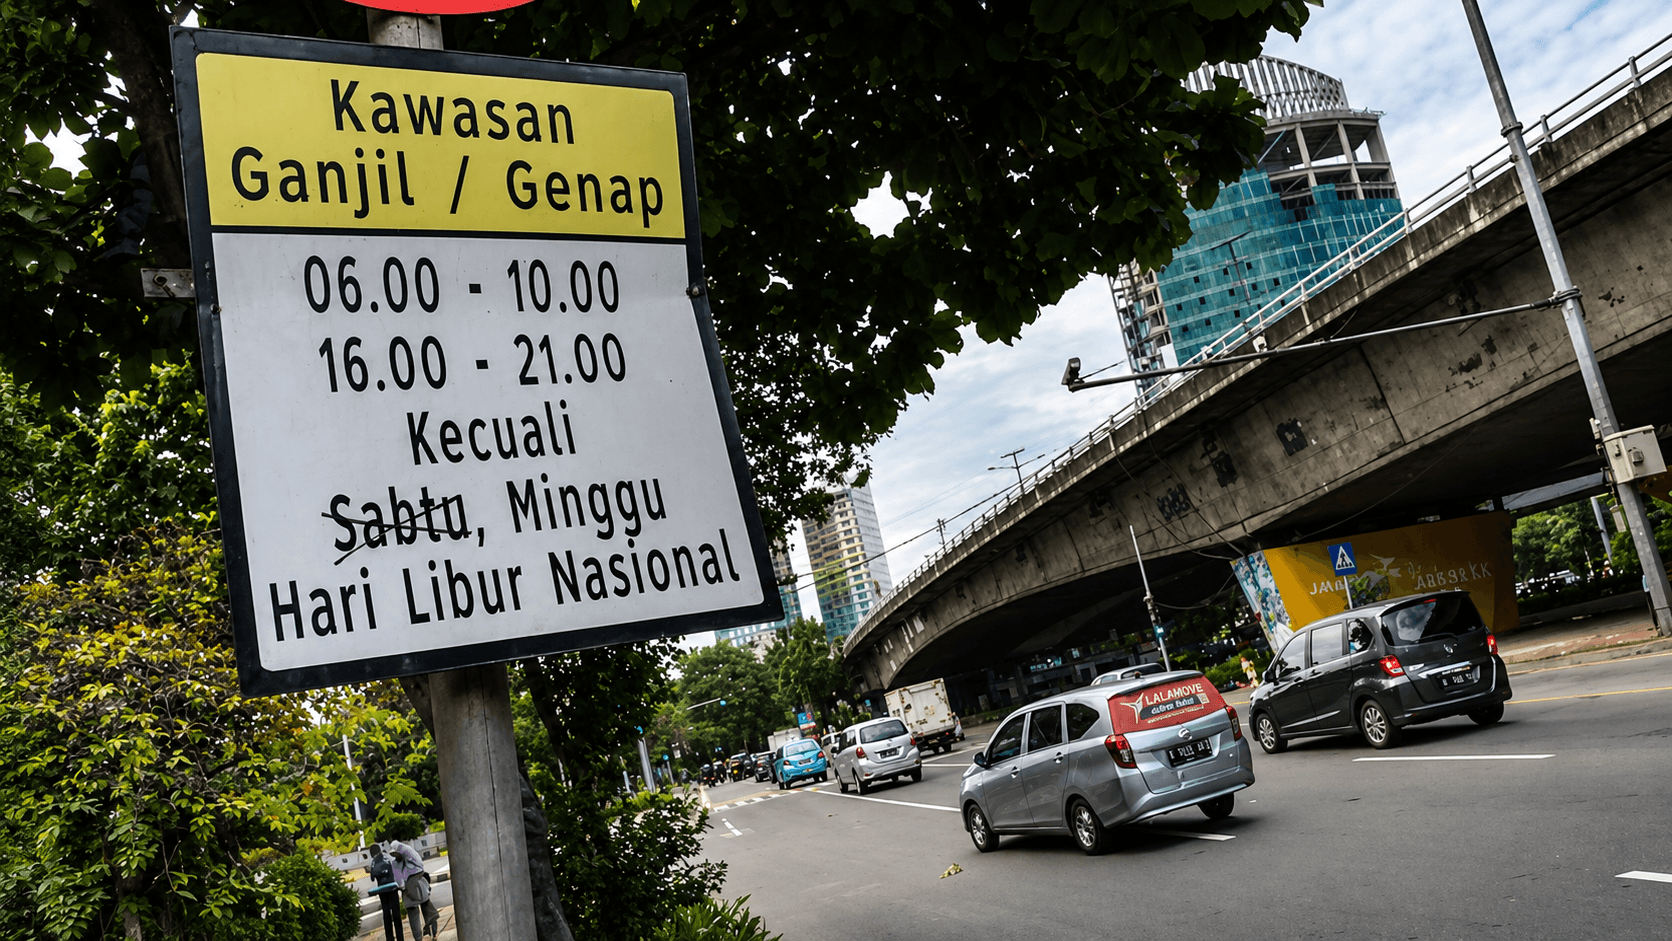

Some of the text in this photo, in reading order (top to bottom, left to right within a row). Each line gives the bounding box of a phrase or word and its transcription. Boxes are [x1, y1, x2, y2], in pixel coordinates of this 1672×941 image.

[331, 79, 575, 145] Kawasan
[231, 146, 664, 229] Ganjil / Genap
[303, 255, 440, 314] 06.00
[507, 259, 619, 313] 10.00
[318, 335, 447, 393] 16.00
[513, 332, 626, 386] 21.00
[406, 400, 577, 466] Kecuali
[329, 473, 667, 551] Sabtu, Minggu
[269, 528, 741, 642] Hari Libur Nasional
[1145, 683, 1204, 706] LALAMOVE
